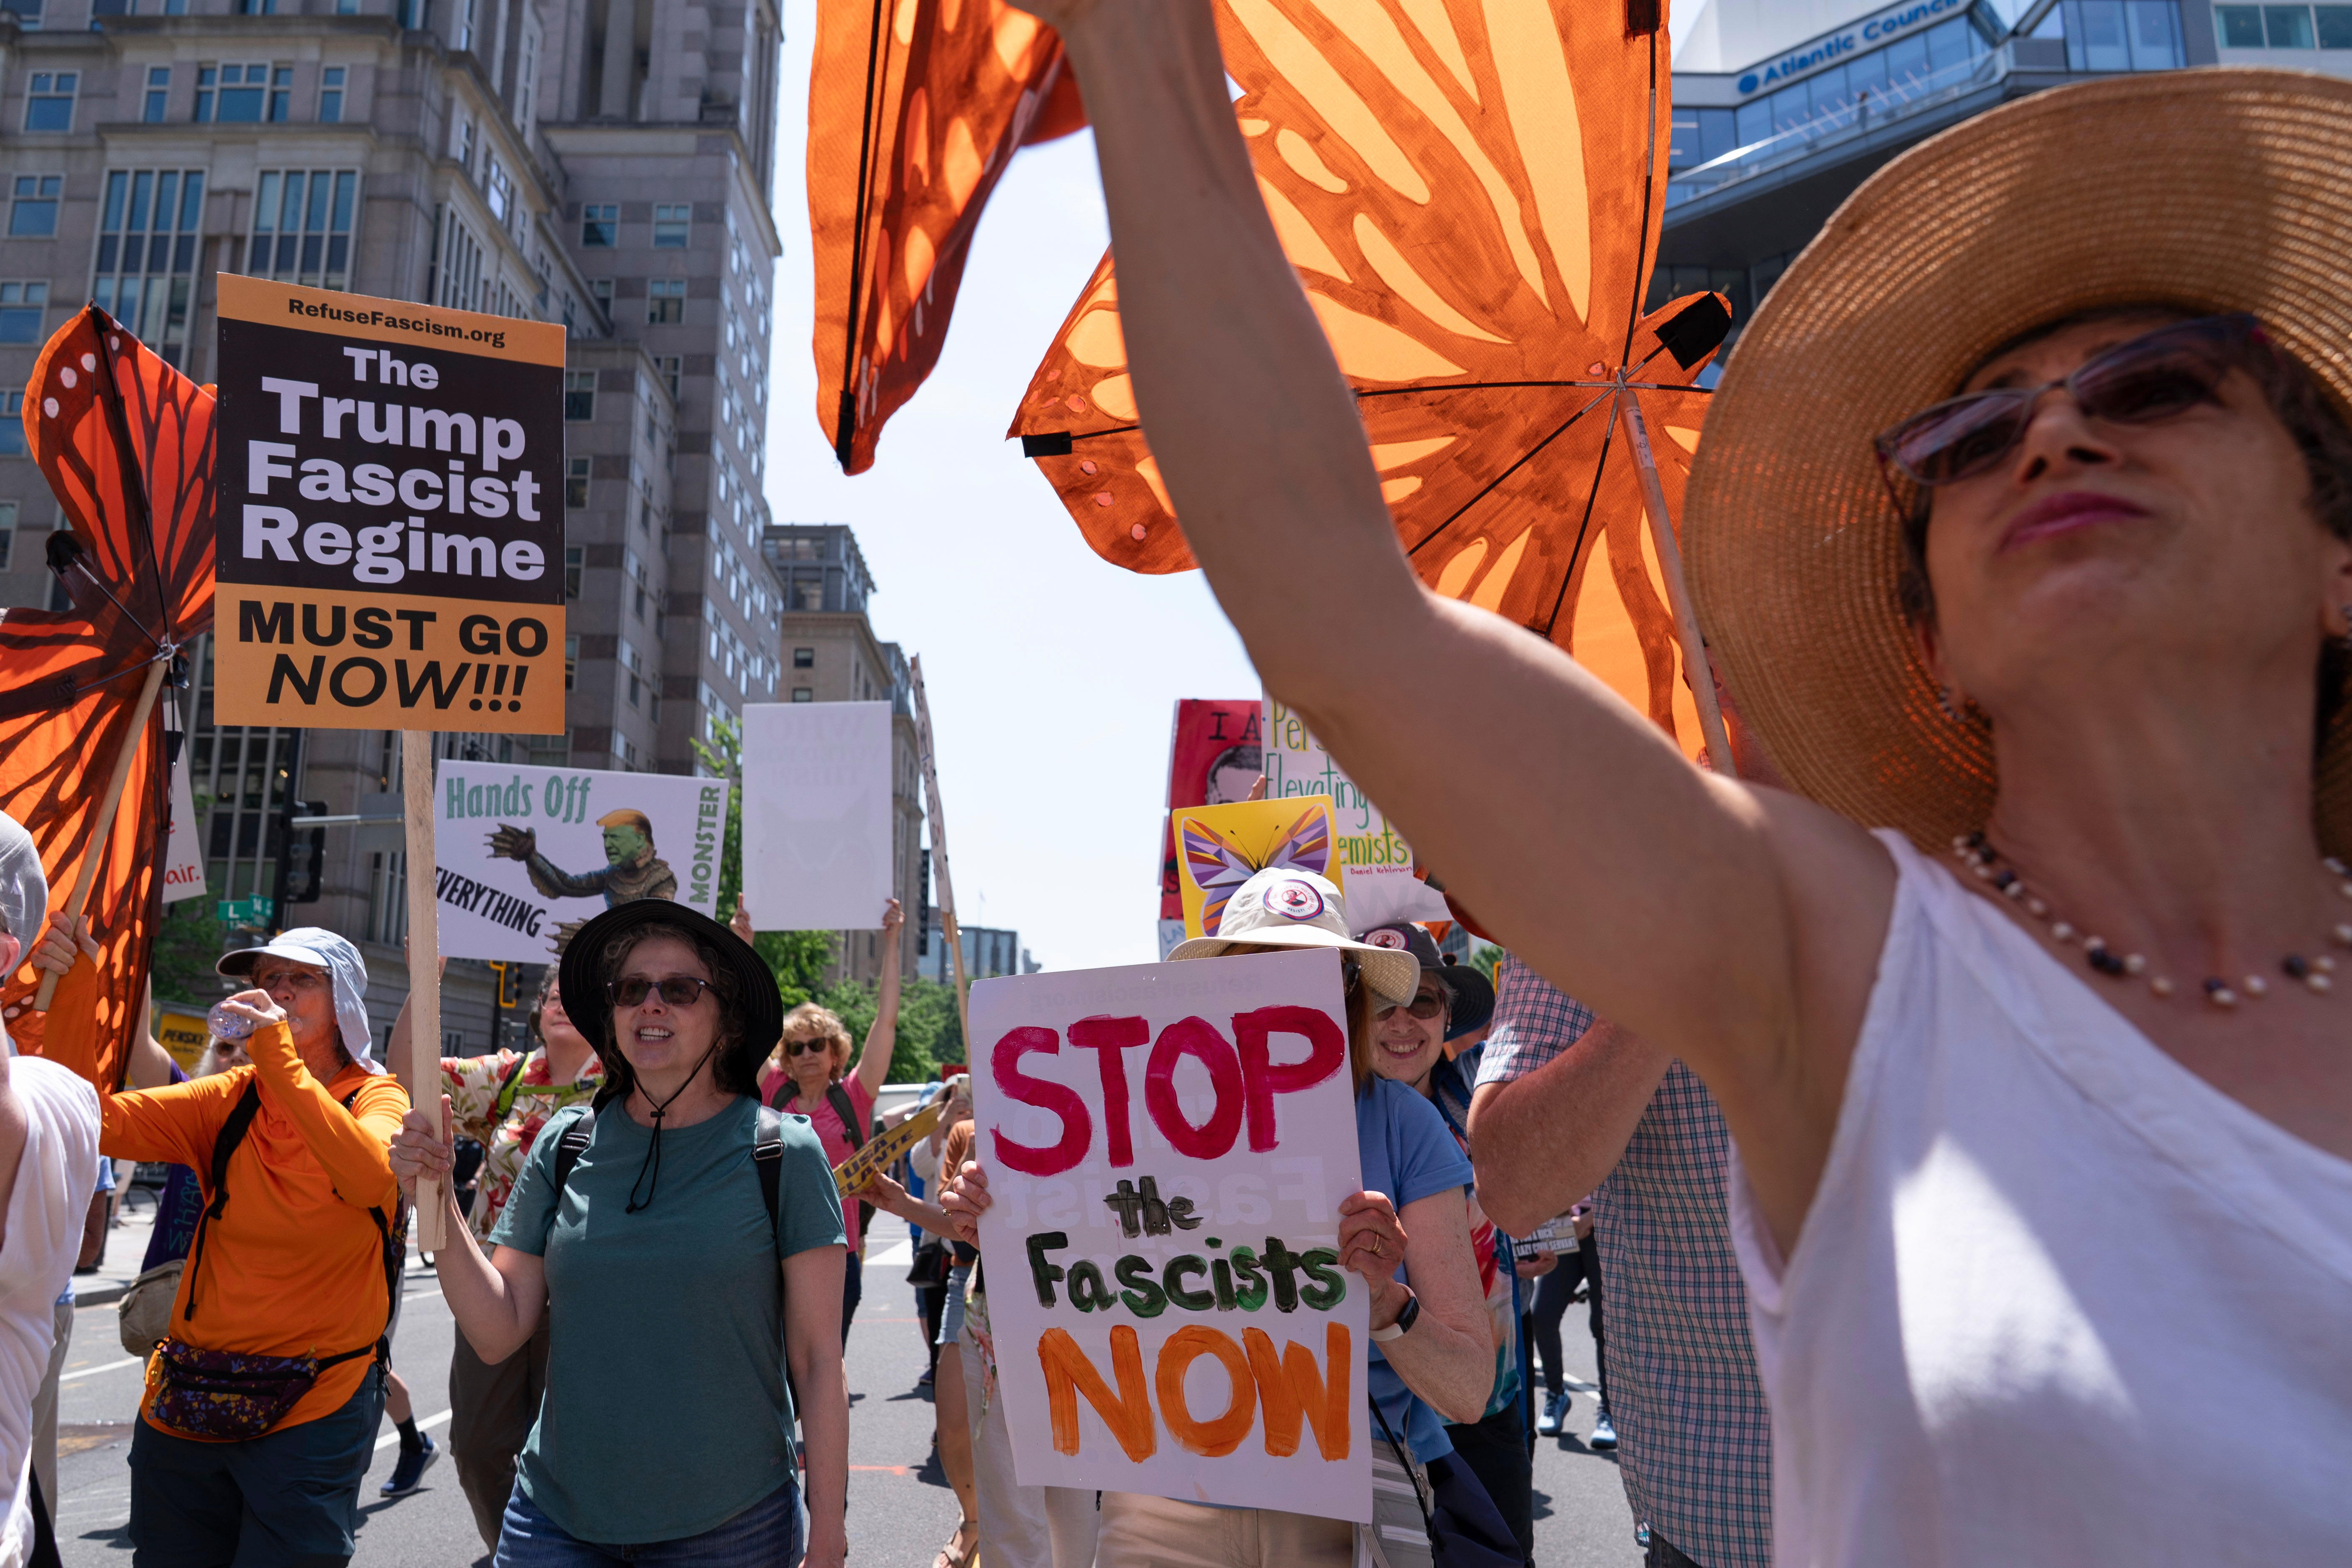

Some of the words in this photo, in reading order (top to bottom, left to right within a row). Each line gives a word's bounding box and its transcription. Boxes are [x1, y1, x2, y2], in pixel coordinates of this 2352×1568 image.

[1764, 33, 1855, 84] Atlantic
[288, 298, 505, 349] RefuseFascism.org
[343, 347, 439, 390] The
[261, 376, 526, 472] Trump
[248, 440, 541, 522] Fascist
[242, 504, 545, 584] Regime
[239, 600, 437, 651] MUST
[459, 614, 548, 658] GO
[265, 653, 529, 713] NOW!!!
[1208, 712, 1229, 740] I
[446, 775, 533, 819] Hands
[544, 775, 592, 824] Off
[1265, 753, 1370, 830] Elevating
[689, 786, 720, 904] MONSTER
[1337, 814, 1409, 865] emists
[165, 863, 201, 885] air.
[1350, 867, 1373, 875] Daniel
[1377, 864, 1412, 874] Kehlman
[228, 903, 240, 919] L
[990, 1005, 1345, 1177] STOP
[839, 1129, 914, 1196] ELANTE
[842, 1138, 888, 1179] USA
[1104, 1175, 1205, 1239] the
[1026, 1231, 1347, 1318] Fascists
[1516, 1243, 1533, 1257] LAZY
[1037, 1321, 1351, 1463] NOW
